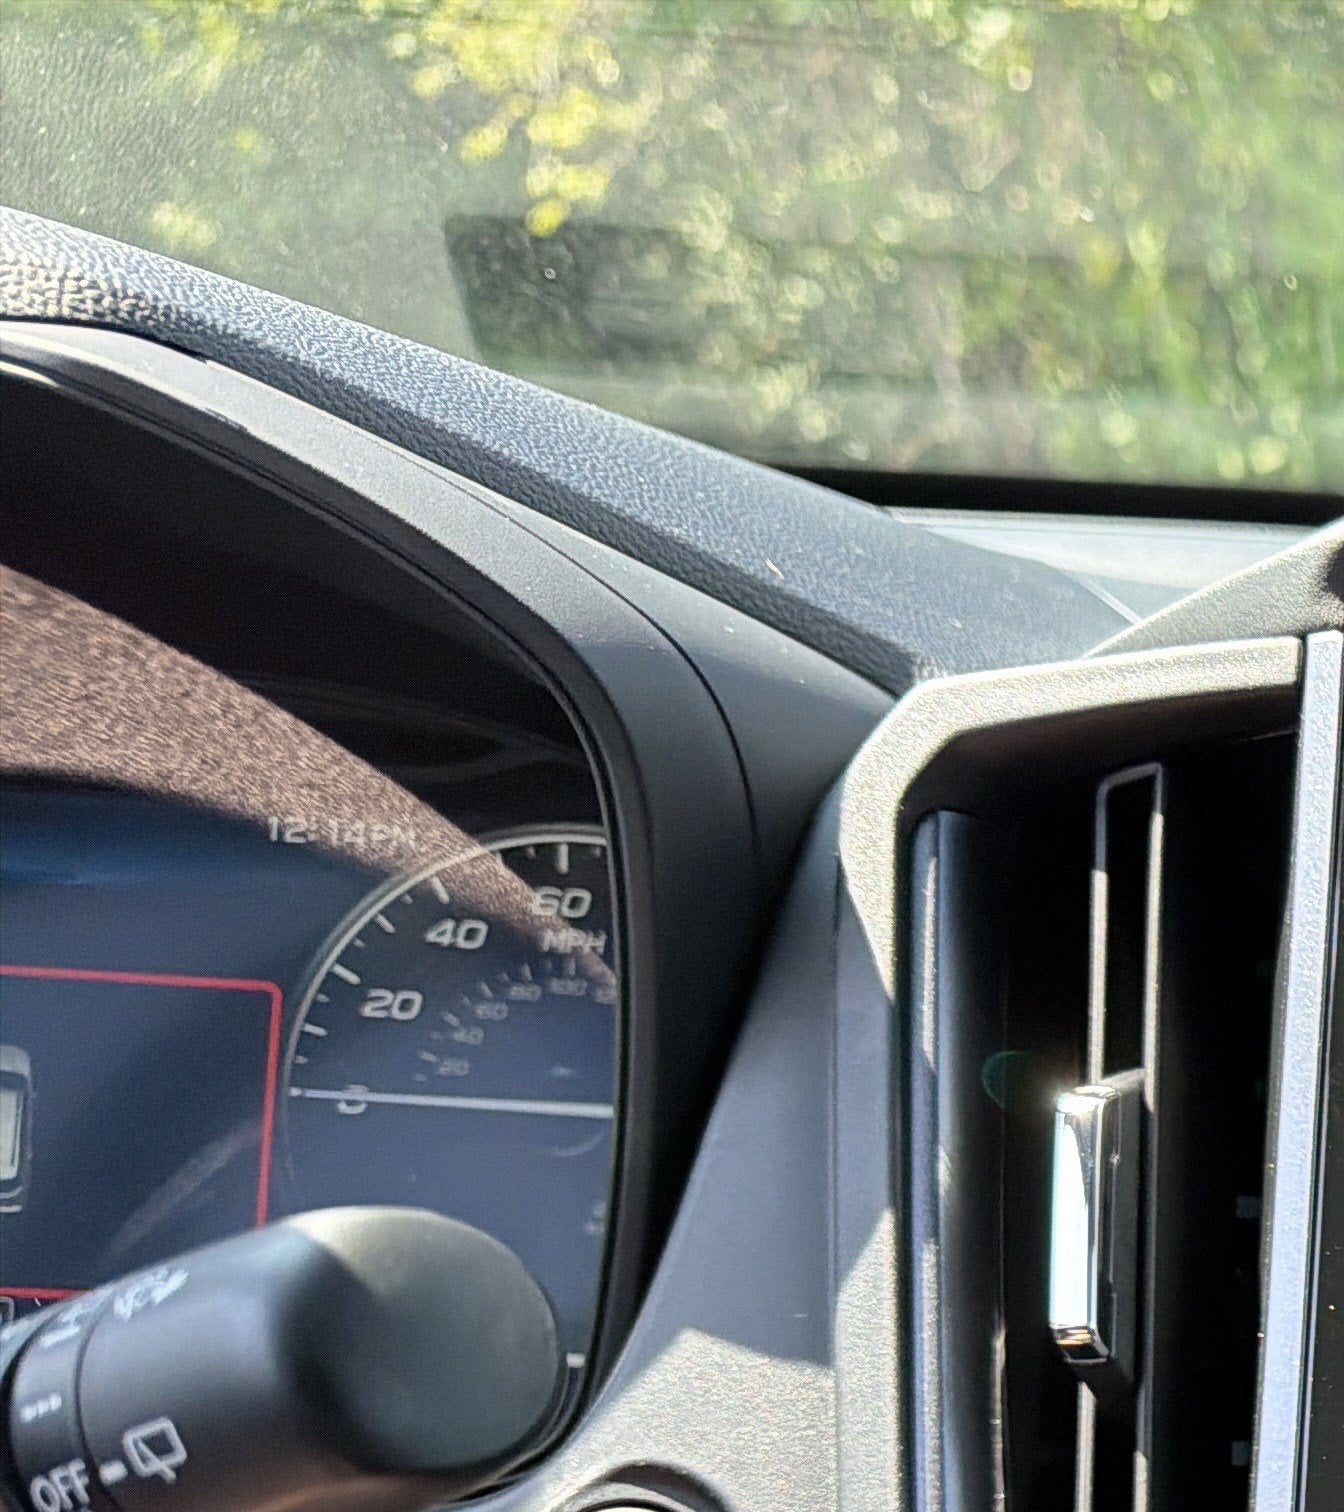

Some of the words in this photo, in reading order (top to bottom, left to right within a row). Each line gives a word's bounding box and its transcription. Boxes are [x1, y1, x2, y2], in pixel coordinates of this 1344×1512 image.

[531, 886, 593, 918] 60
[424, 918, 489, 950] 40
[543, 929, 608, 953] MPH
[360, 987, 423, 1021] 20
